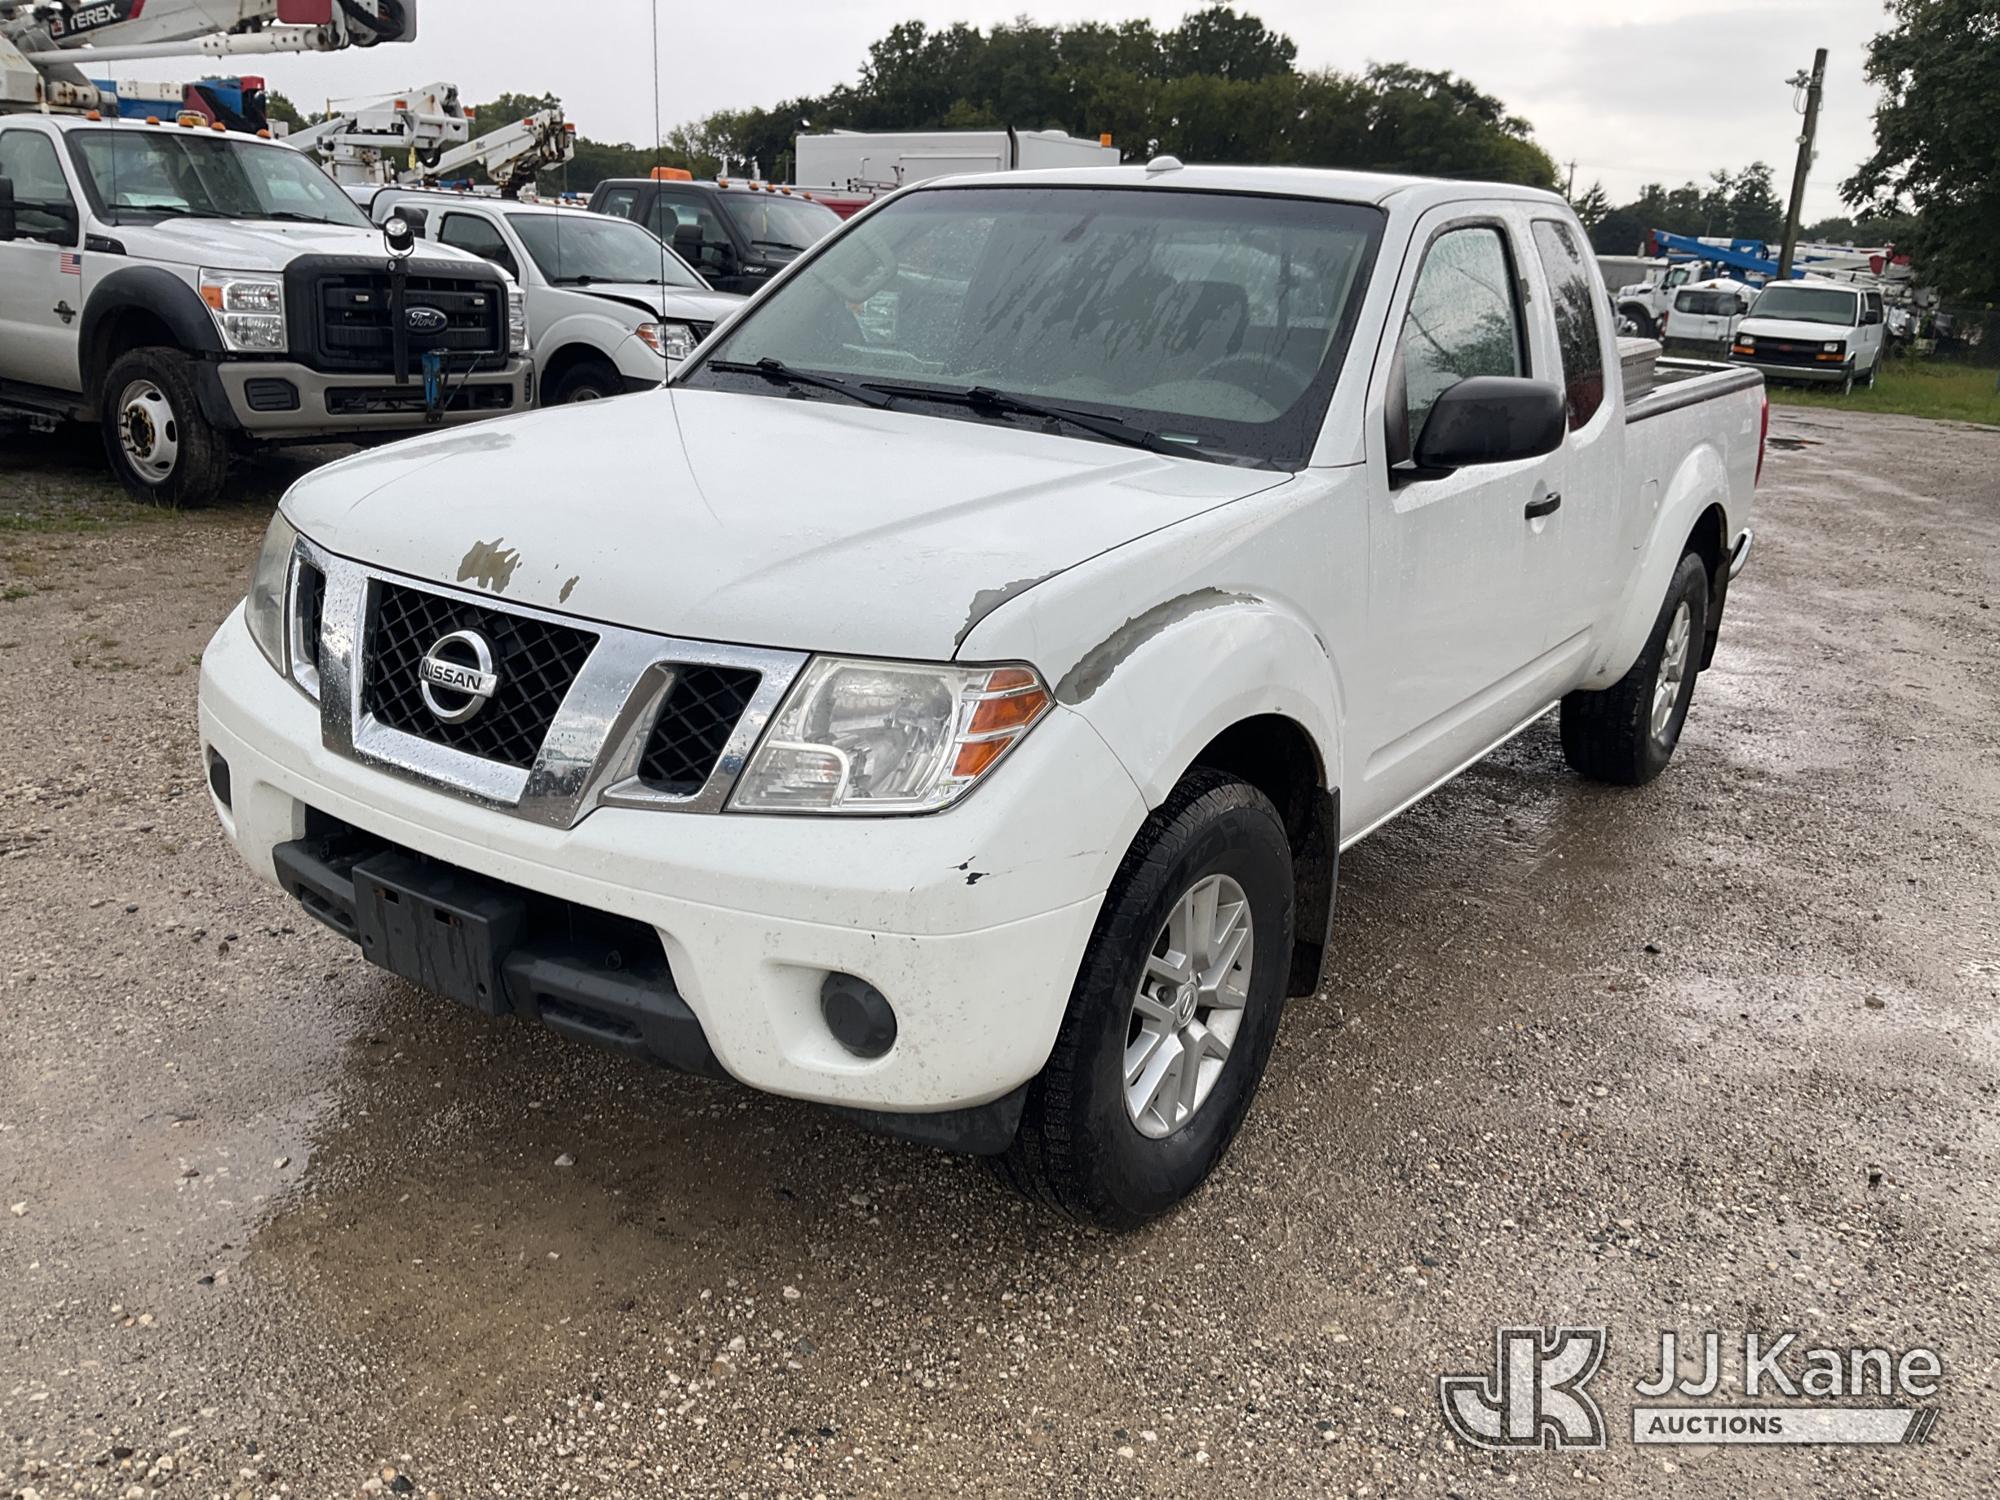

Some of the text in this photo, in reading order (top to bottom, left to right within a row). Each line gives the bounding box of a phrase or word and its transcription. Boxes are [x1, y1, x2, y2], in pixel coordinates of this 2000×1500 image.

[70, 3, 117, 30] TEREX
[409, 311, 438, 327] Ford
[421, 658, 482, 691] NISSAN
